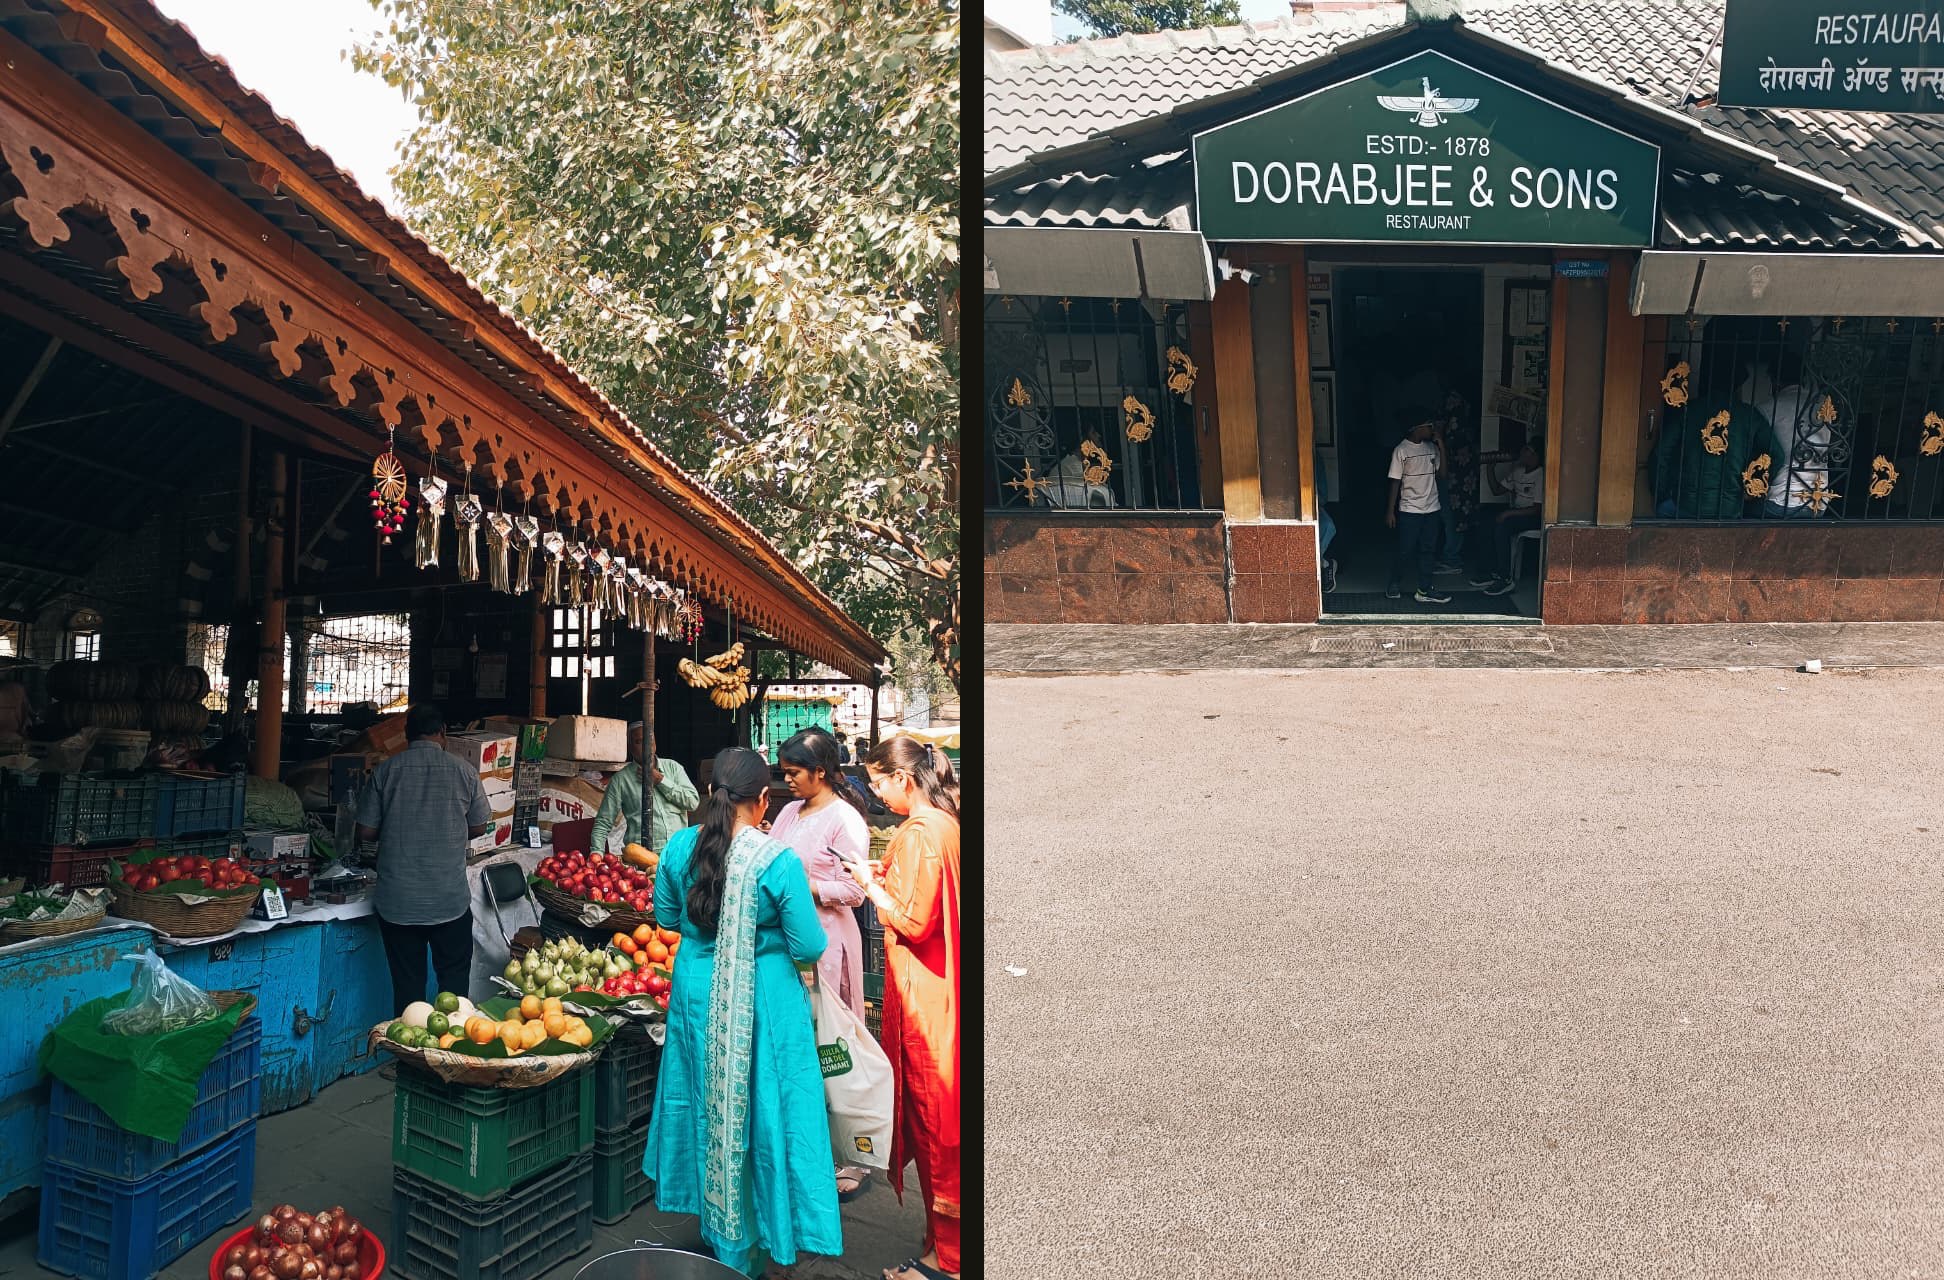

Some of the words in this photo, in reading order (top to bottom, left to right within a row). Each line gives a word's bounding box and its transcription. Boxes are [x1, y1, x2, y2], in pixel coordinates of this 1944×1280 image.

[1815, 12, 1944, 45] RESTAURA
[1759, 56, 1836, 94] दोराबजी
[1366, 134, 1437, 155] ESTD:-
[1444, 136, 1490, 157] 1878
[1231, 160, 1454, 207] DORABJEE
[1468, 165, 1495, 208] &
[1508, 166, 1619, 211] SONS
[1385, 213, 1473, 231] RESTAURANT
[820, 1056, 833, 1065] VIA
